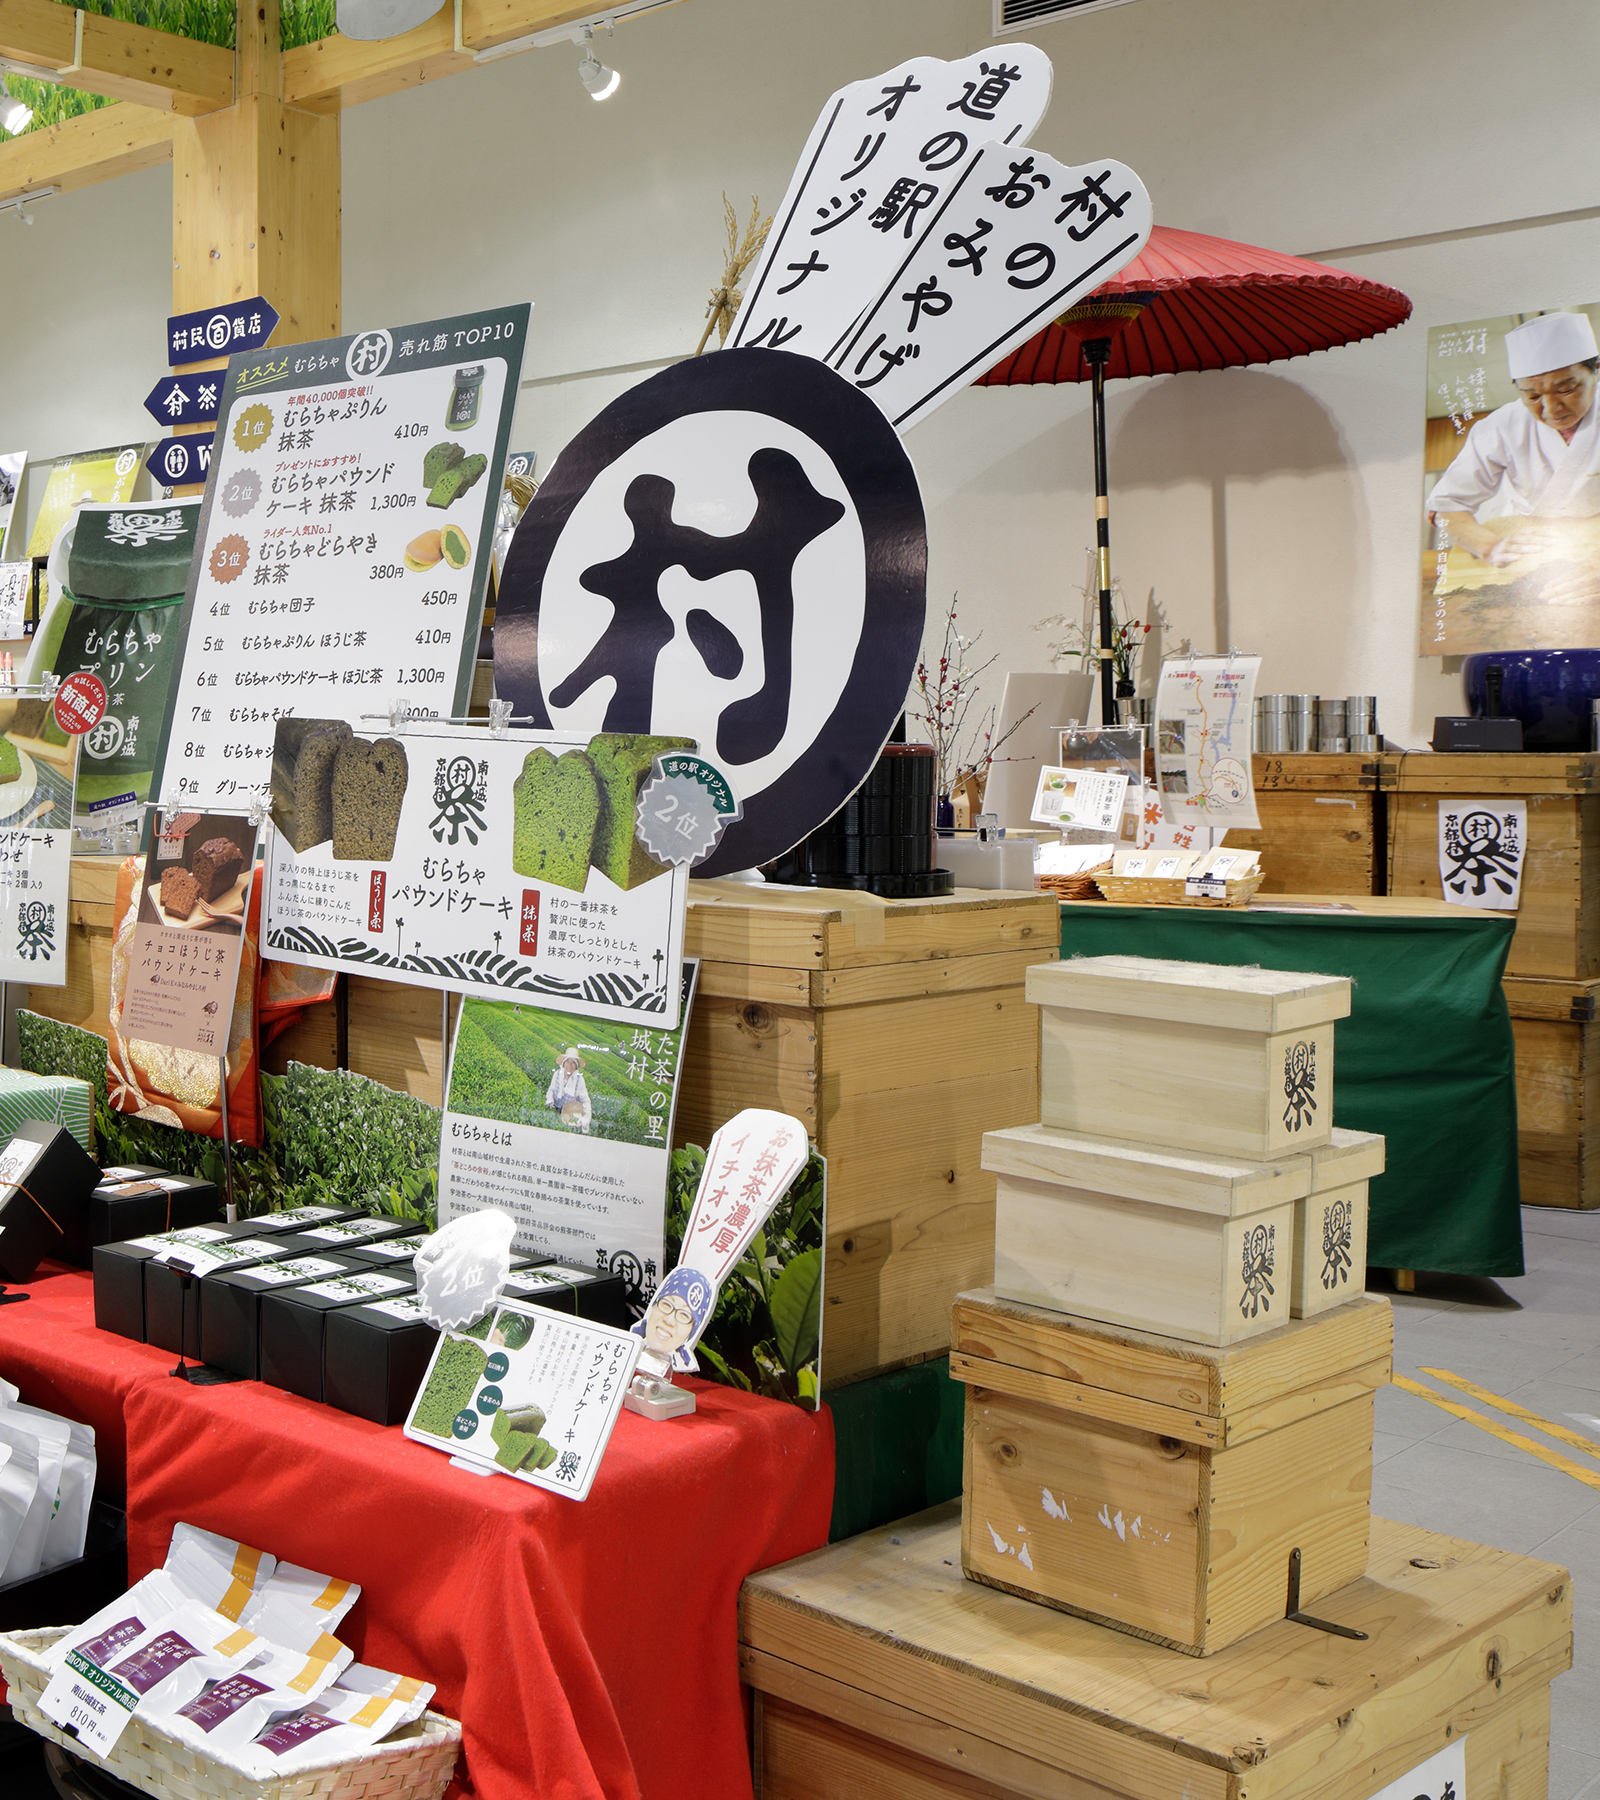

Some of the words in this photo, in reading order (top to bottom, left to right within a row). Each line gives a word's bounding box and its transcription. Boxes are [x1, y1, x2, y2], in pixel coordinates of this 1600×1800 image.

[868, 63, 1021, 239] 道の駅
[746, 74, 920, 348] オリジナル
[1004, 169, 1130, 290] 村の
[856, 156, 1052, 388] おみやげ
[173, 313, 261, 351] 村民百貨店
[237, 357, 288, 384] オススメ
[294, 357, 340, 373] むらちゃ
[399, 333, 447, 357] 売れ筋
[454, 321, 515, 348] TOP10
[242, 420, 266, 437] 1位
[283, 397, 388, 429] むらちゃぷりん
[277, 428, 315, 453] 抹茶
[394, 424, 429, 440] 410円
[231, 484, 254, 501] 2位
[271, 462, 395, 494] むらちゃパウンド
[265, 496, 313, 518] ケーキ
[318, 490, 357, 515] 抹茶
[370, 494, 417, 512] 1,300円
[217, 550, 241, 568] 3位
[259, 532, 378, 561] むらちゃどらやき
[253, 563, 290, 586] 抹茶
[369, 564, 404, 580] 380円
[1434, 518, 1450, 642] おらが自慢のつちのうぶ
[209, 600, 231, 617] 4位
[248, 597, 315, 615] むらちゃ団子
[421, 590, 457, 606] 450円
[549, 447, 846, 767] 村
[85, 628, 162, 656] むらちゃ
[203, 636, 224, 652] 5位
[242, 634, 315, 651] むらちゃぷりん
[320, 631, 367, 648] ほうじ茶
[415, 629, 451, 645] 410円
[74, 677, 104, 706] お試しください
[197, 671, 218, 688] 6位
[234, 670, 339, 687] むらちゃパウンドケーキ
[342, 668, 383, 685] ほうじ茶
[396, 668, 445, 684] 1,300円
[60, 684, 99, 725] 新商品
[191, 706, 212, 723] 7位
[184, 742, 205, 759] 8位
[178, 778, 199, 794] 9位
[668, 760, 699, 775] 道の駅
[699, 768, 728, 808] オリジナル
[654, 795, 700, 840] 2位
[1499, 813, 1520, 854] 南山城
[15, 879, 28, 889] 2個
[30, 881, 43, 890] 入り
[16, 869, 29, 879] 3個
[279, 863, 359, 882] 深入りの特上ほうじ茶を
[279, 877, 336, 894] まっ黒になるまで
[423, 857, 486, 886] むらちゃ
[277, 906, 362, 927] ほうじ茶のパウンドケーキ
[278, 892, 351, 911] ふんだんに練りこんだ
[370, 873, 383, 931] ほうじ茶
[392, 884, 514, 921] パウンドケーキ
[549, 896, 619, 915] 村の一番抹茶を
[521, 904, 538, 944] 抹茶
[549, 913, 606, 931] 贅沢に使った
[145, 940, 225, 964] チョコほうじ茶
[547, 946, 641, 969] 抹茶のパウンドケーキ
[548, 929, 638, 952] 濃厚でしっとりとした
[142, 958, 221, 981] パウンドケーキ
[626, 1030, 652, 1082] 城村
[644, 1033, 674, 1141] た茶の里
[451, 1122, 512, 1147] むらちゃとは
[698, 1133, 752, 1233] イチオシ
[710, 1126, 790, 1254] お抹茶濃厚
[440, 1264, 484, 1299] 2位
[600, 1343, 626, 1404] むらちゃ
[564, 1340, 611, 1443] パウンドケーキ
[71, 1683, 108, 1716] 南山城紅茶
[87, 1669, 138, 1711] オリジナル商品
